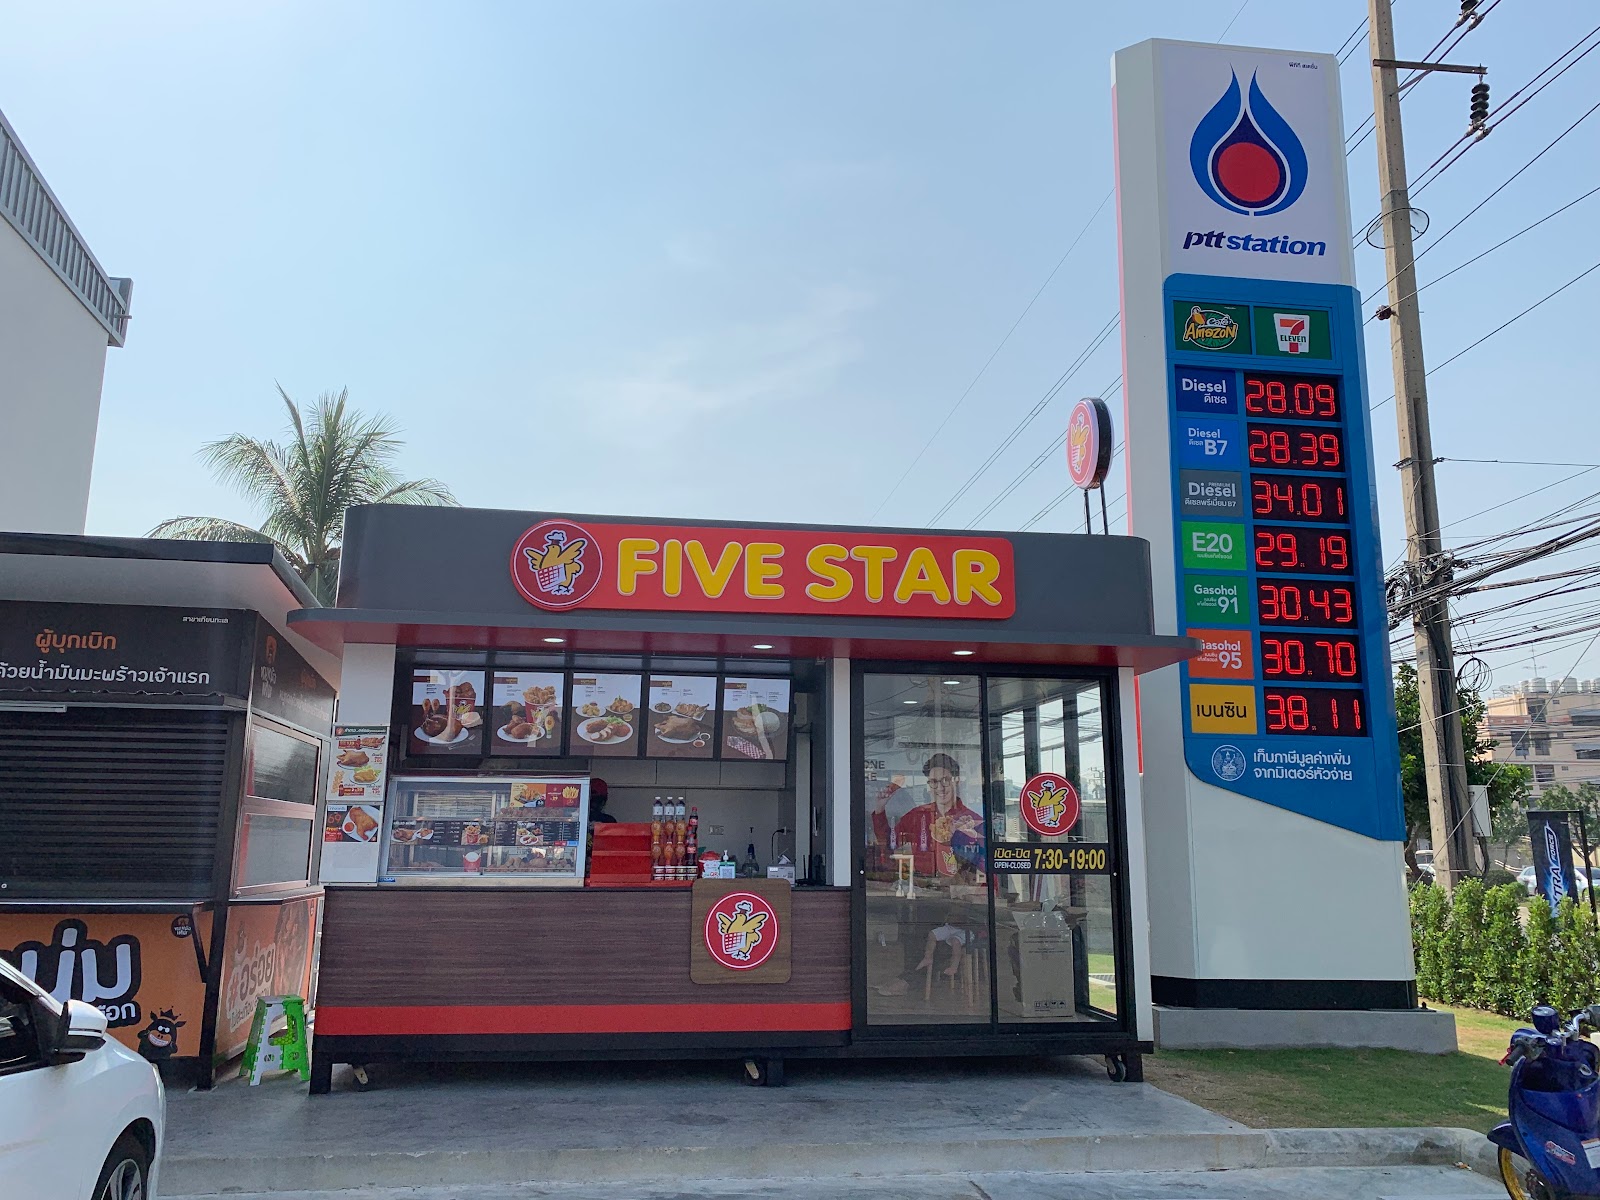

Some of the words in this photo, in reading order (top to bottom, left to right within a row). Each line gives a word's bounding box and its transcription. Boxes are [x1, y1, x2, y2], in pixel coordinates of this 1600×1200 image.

[1182, 378, 1227, 393] Diesel
[1245, 380, 1335, 416] 28.09
[1203, 393, 1227, 404] ดีเซล
[1188, 427, 1221, 438] Diesel
[1250, 430, 1340, 466] 28.39
[1204, 439, 1228, 456] B7
[1188, 482, 1236, 498] Diesel
[1253, 480, 1344, 516] 34.01
[1227, 500, 1237, 508] B7
[1192, 531, 1233, 553] E20
[1256, 532, 1348, 569] 29.19
[616, 538, 785, 599] FIVE
[805, 543, 1003, 605] STAR
[1193, 584, 1238, 596] Gasohol
[1260, 585, 1353, 622] 30.43
[1217, 596, 1239, 614] 91
[35, 628, 117, 654] ผู้บุกเบิก
[1218, 651, 1243, 670] 95
[1263, 639, 1357, 677] 30.70
[1196, 701, 1247, 718] เบนซิน
[1266, 694, 1362, 731] 38.11
[1253, 748, 1351, 767] เก็บภาษีมูลค่าเพิ่ม
[1253, 766, 1353, 781] จากมิเตอร์หัวจ่าย
[994, 848, 1031, 859] เปิด-ปิด
[1034, 848, 1106, 870] 7:30-19:00
[994, 861, 1032, 869] OPEN-CLOSED
